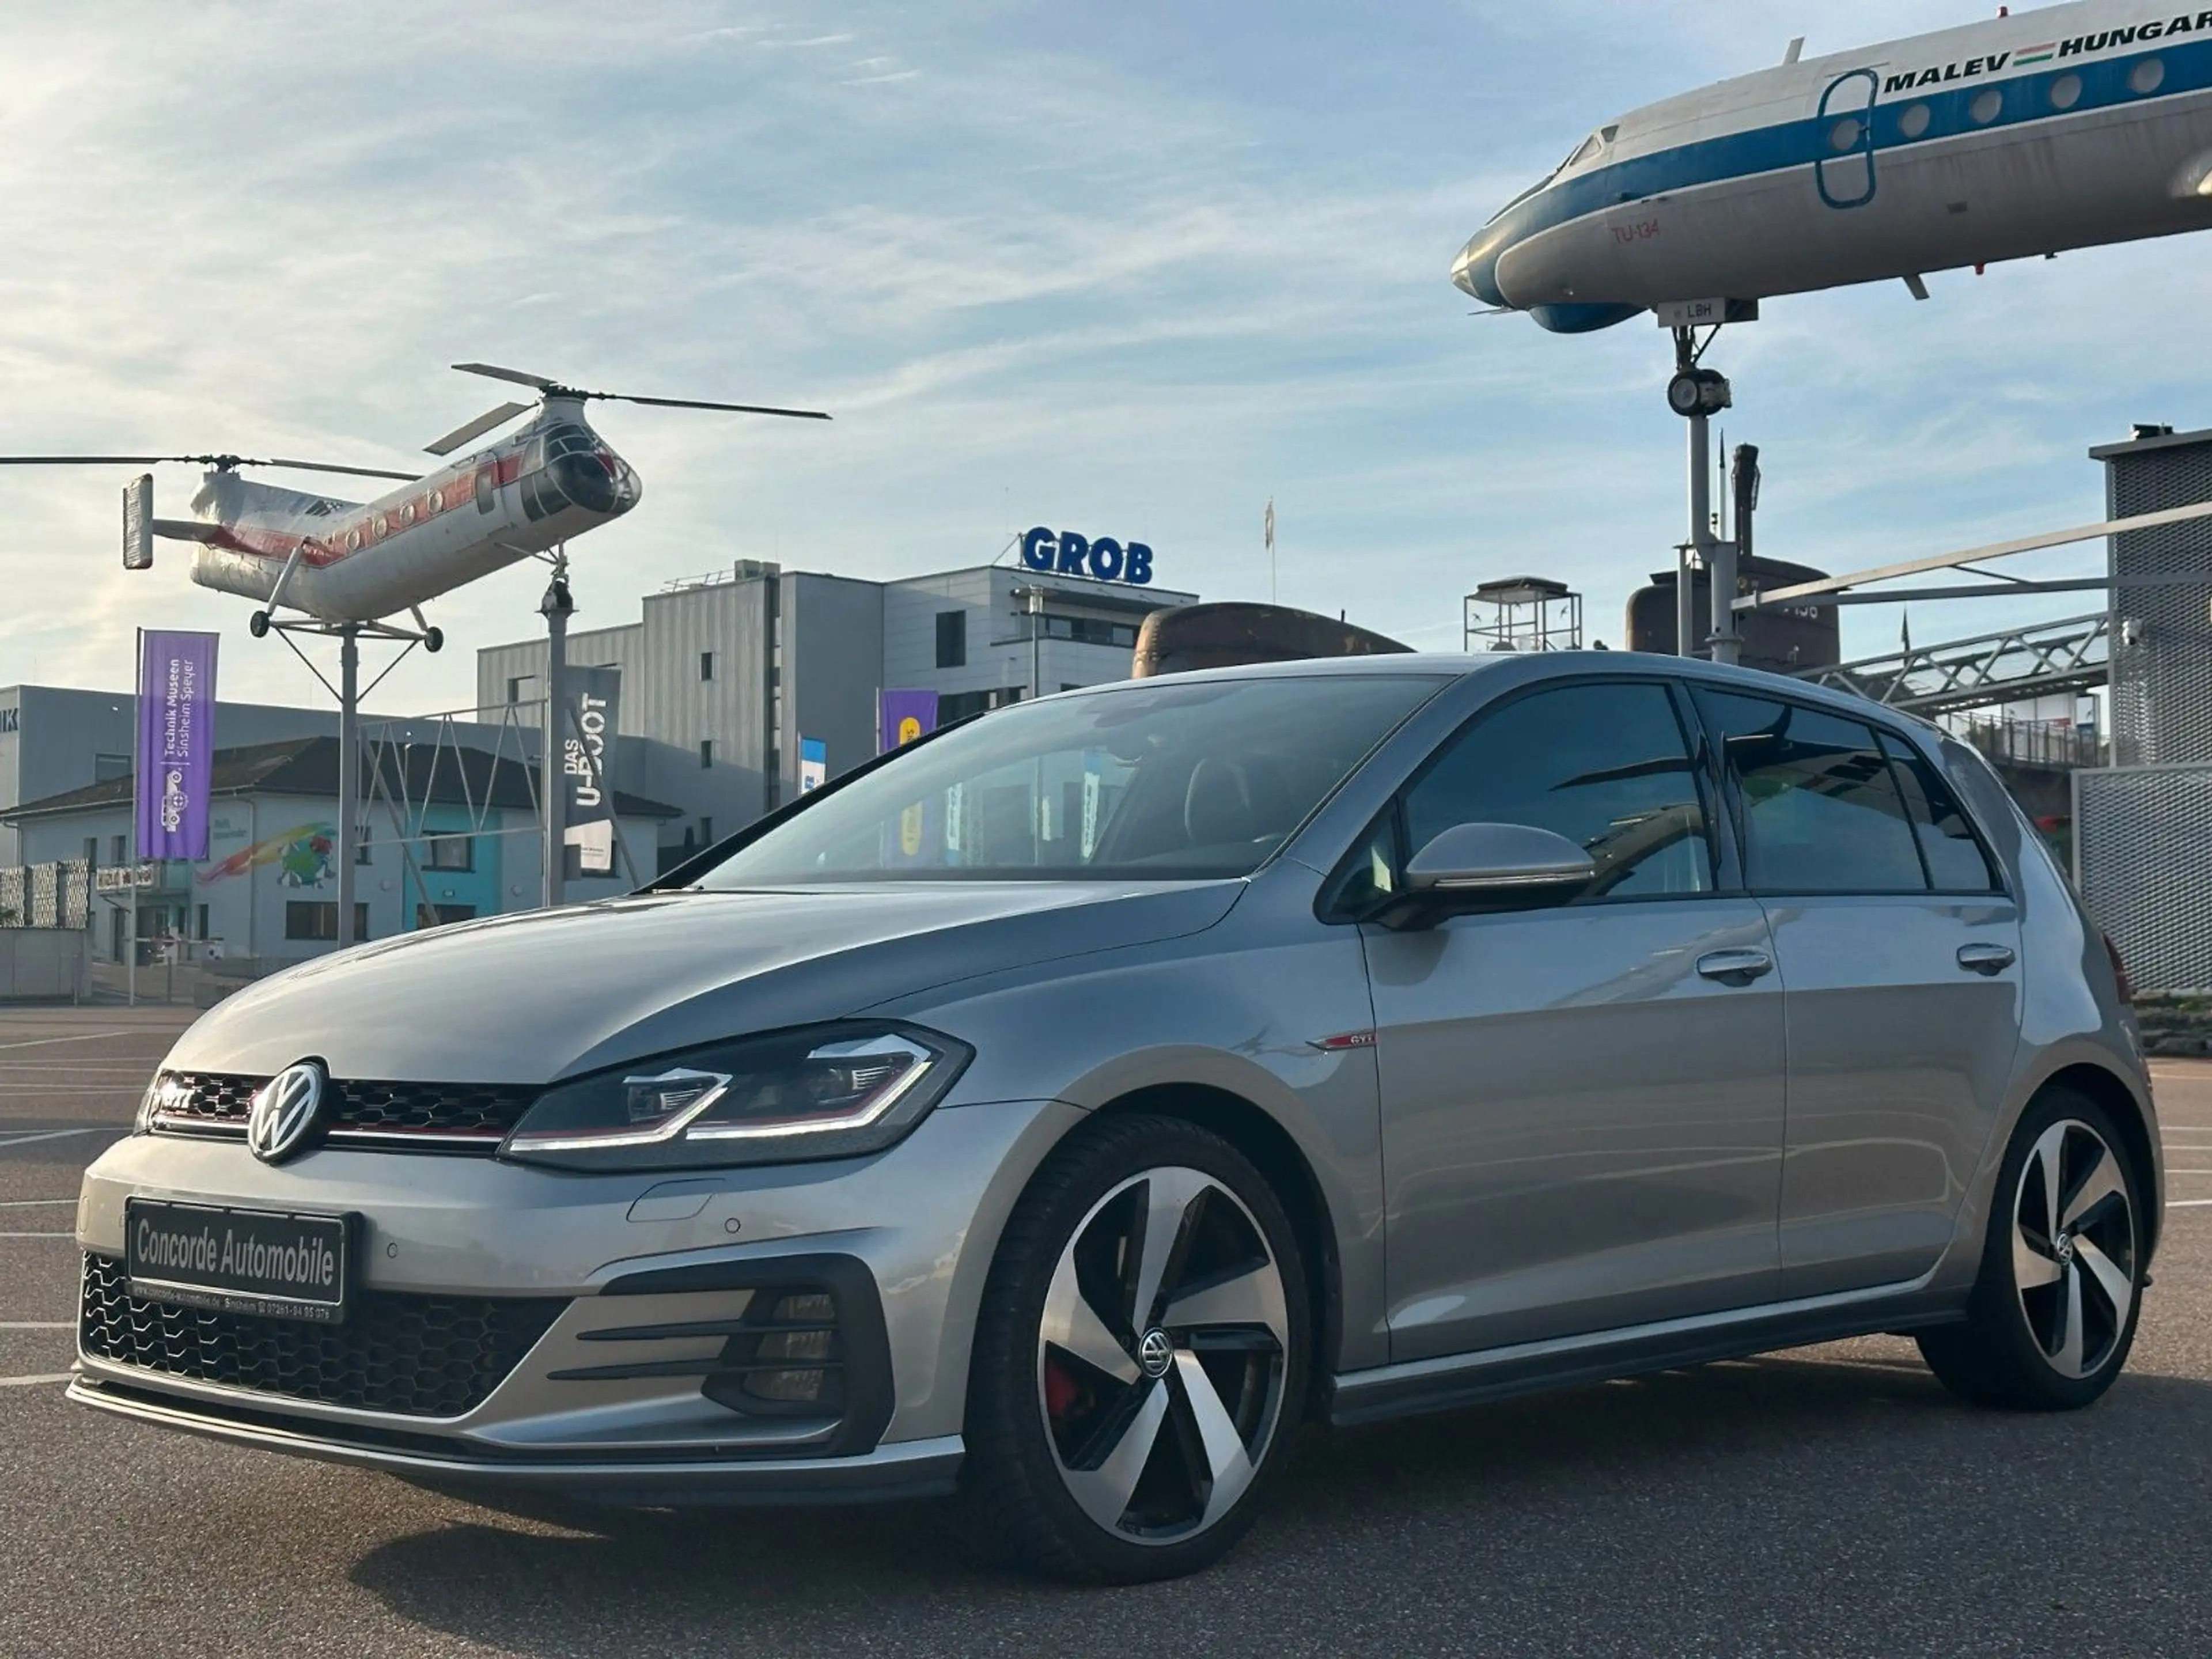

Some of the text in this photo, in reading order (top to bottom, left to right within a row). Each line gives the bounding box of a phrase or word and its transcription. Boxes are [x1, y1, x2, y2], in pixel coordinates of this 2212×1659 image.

[1884, 51, 2012, 93] MALEV
[1611, 218, 1660, 244] TU-134
[1023, 527, 1153, 584] GROB
[0, 707, 18, 733] IK
[165, 659, 180, 756] Technik Museen
[177, 660, 196, 757] Sinsheim Speyer
[564, 739, 579, 775] DAS
[576, 692, 607, 806] U-BOOT
[138, 1218, 334, 1286] Concorde Automobile
